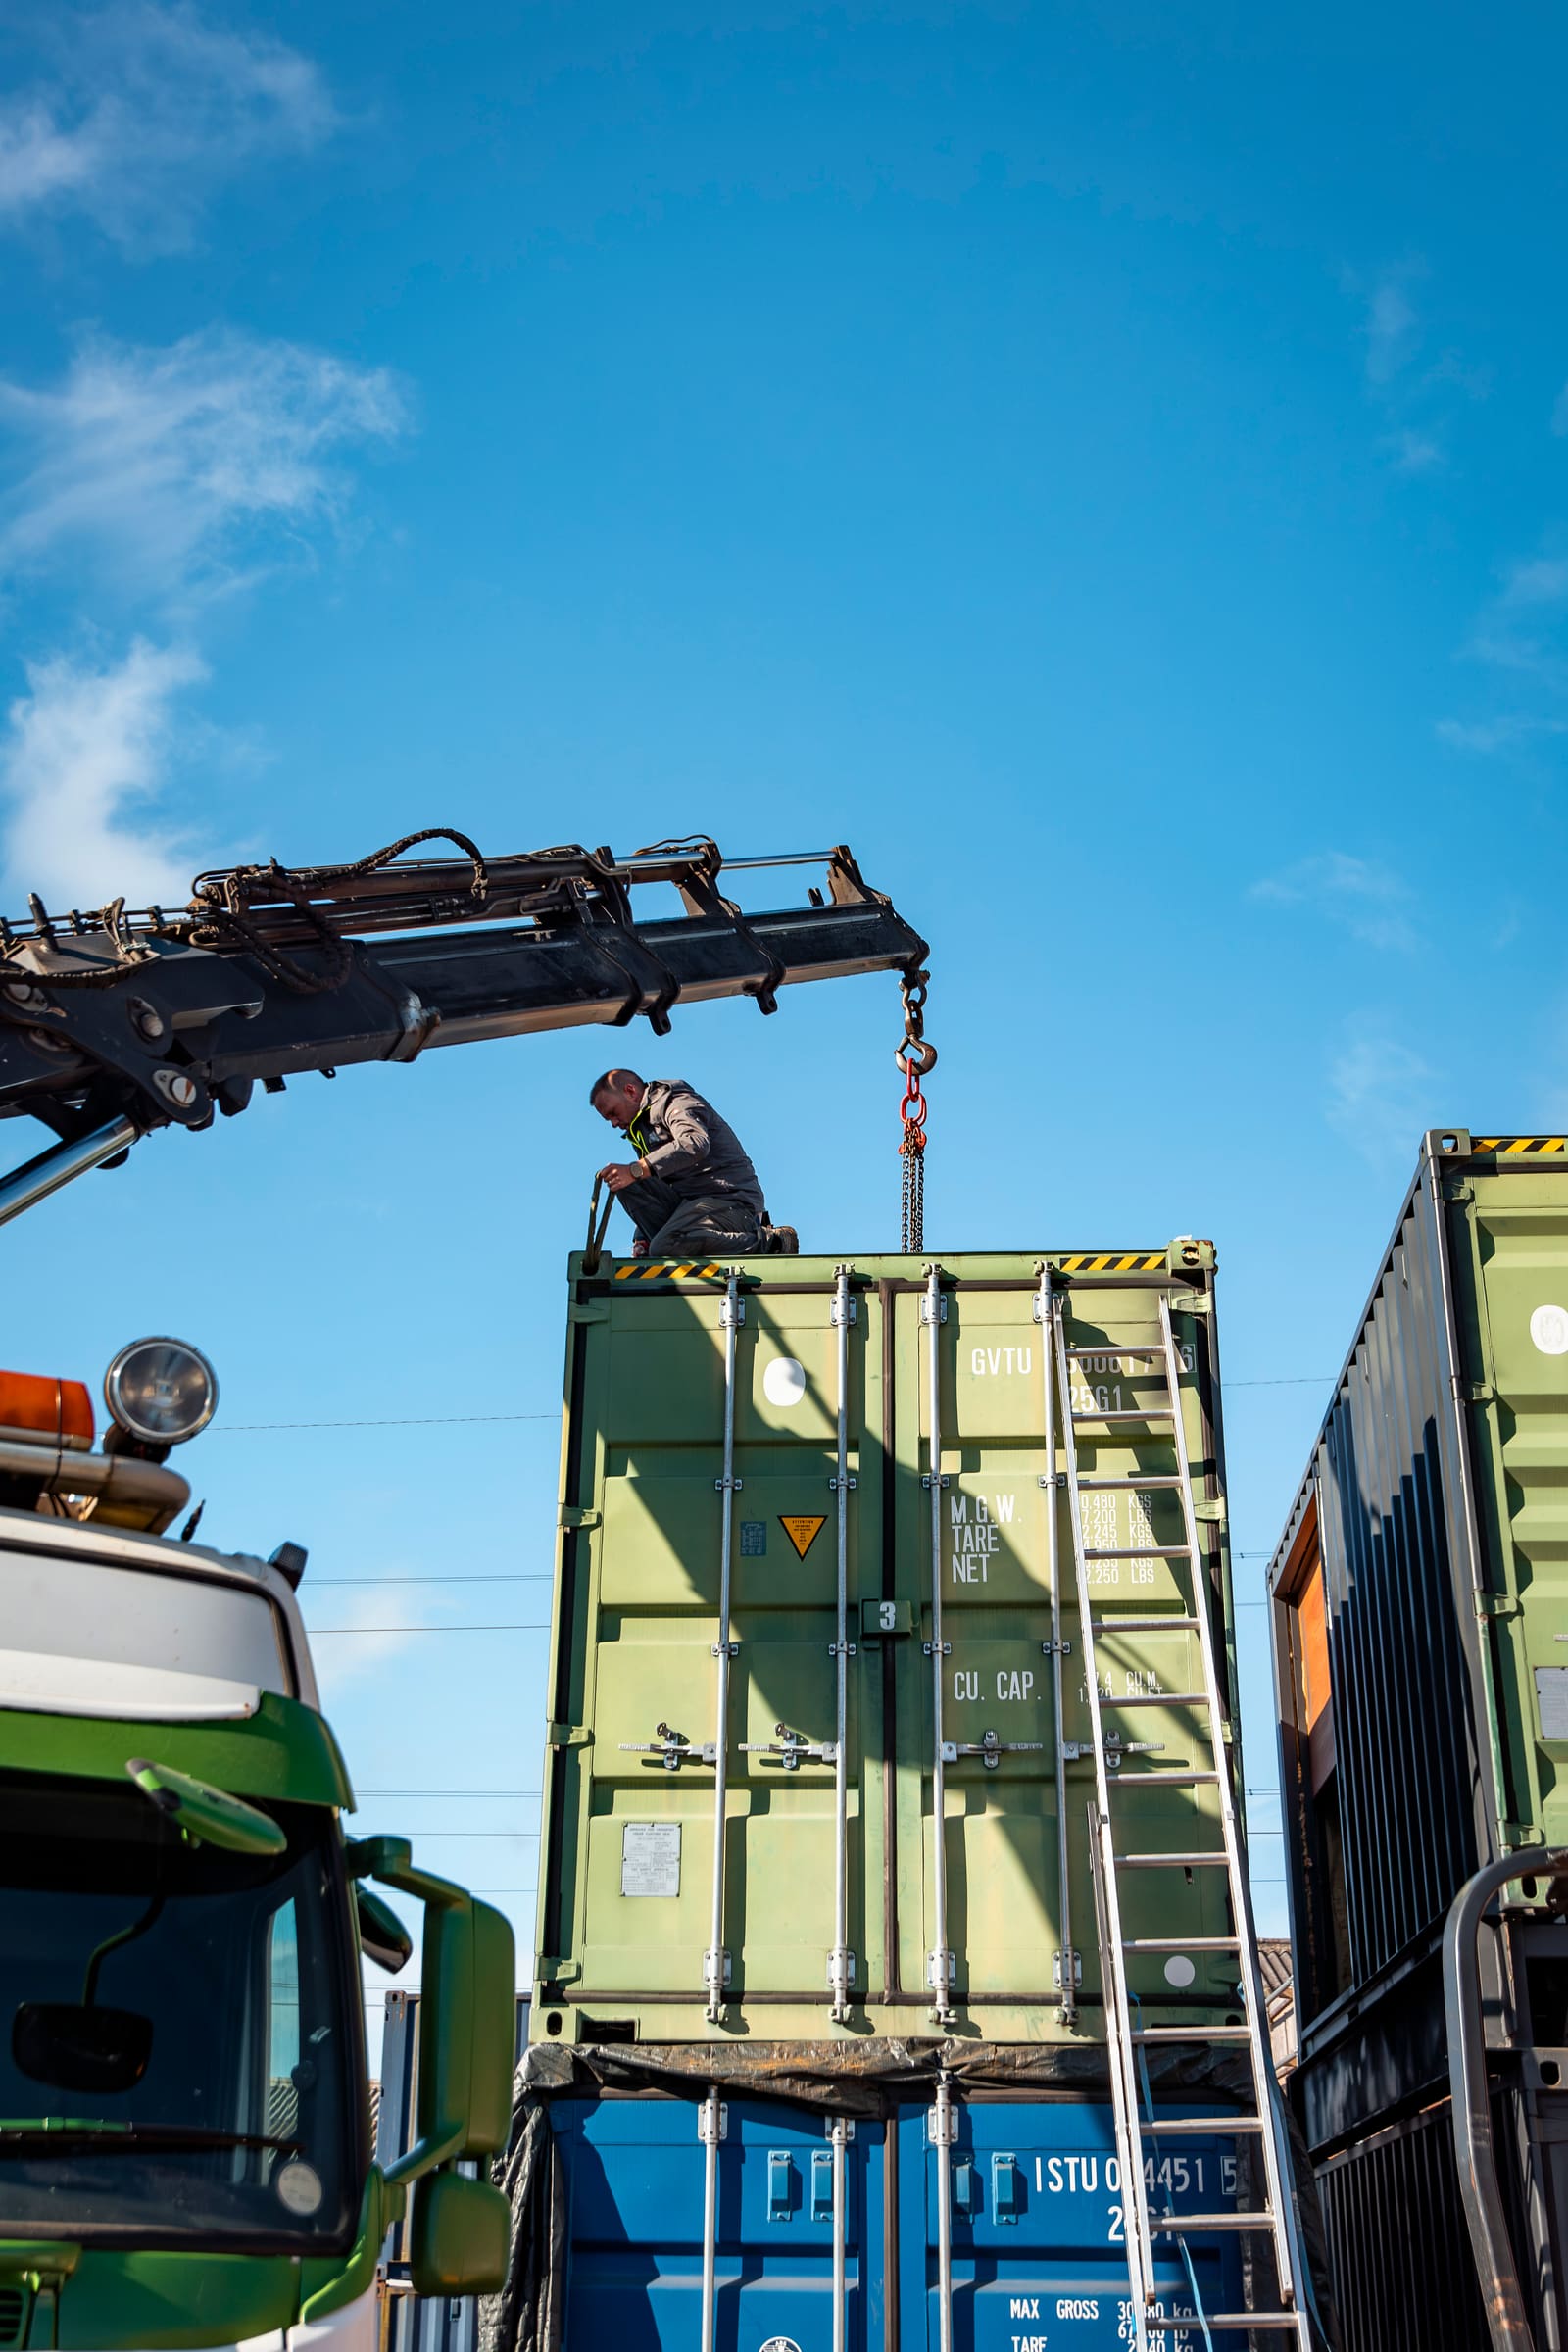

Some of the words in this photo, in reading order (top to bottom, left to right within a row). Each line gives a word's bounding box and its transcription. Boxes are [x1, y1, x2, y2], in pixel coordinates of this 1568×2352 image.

[971, 1348, 1032, 1376] GVTU
[1180, 1346, 1194, 1371] 6
[950, 1494, 1022, 1524] M.G.W.
[1081, 1494, 1116, 1510] 0.480
[1128, 1494, 1152, 1509] KGS
[1128, 1509, 1152, 1524] LBS
[951, 1525, 1000, 1552] TARE
[1129, 1524, 1152, 1539] KGS
[952, 1554, 990, 1583] NET
[1131, 1568, 1154, 1584] LBS
[879, 1601, 896, 1631] 3
[954, 1671, 985, 1700] CU.
[996, 1671, 1042, 1700] CAP.
[1035, 2157, 1098, 2192] ISTU
[1105, 2157, 1204, 2192] 04451
[1009, 2299, 1040, 2320] MAX
[1056, 2299, 1099, 2320] GROSS
